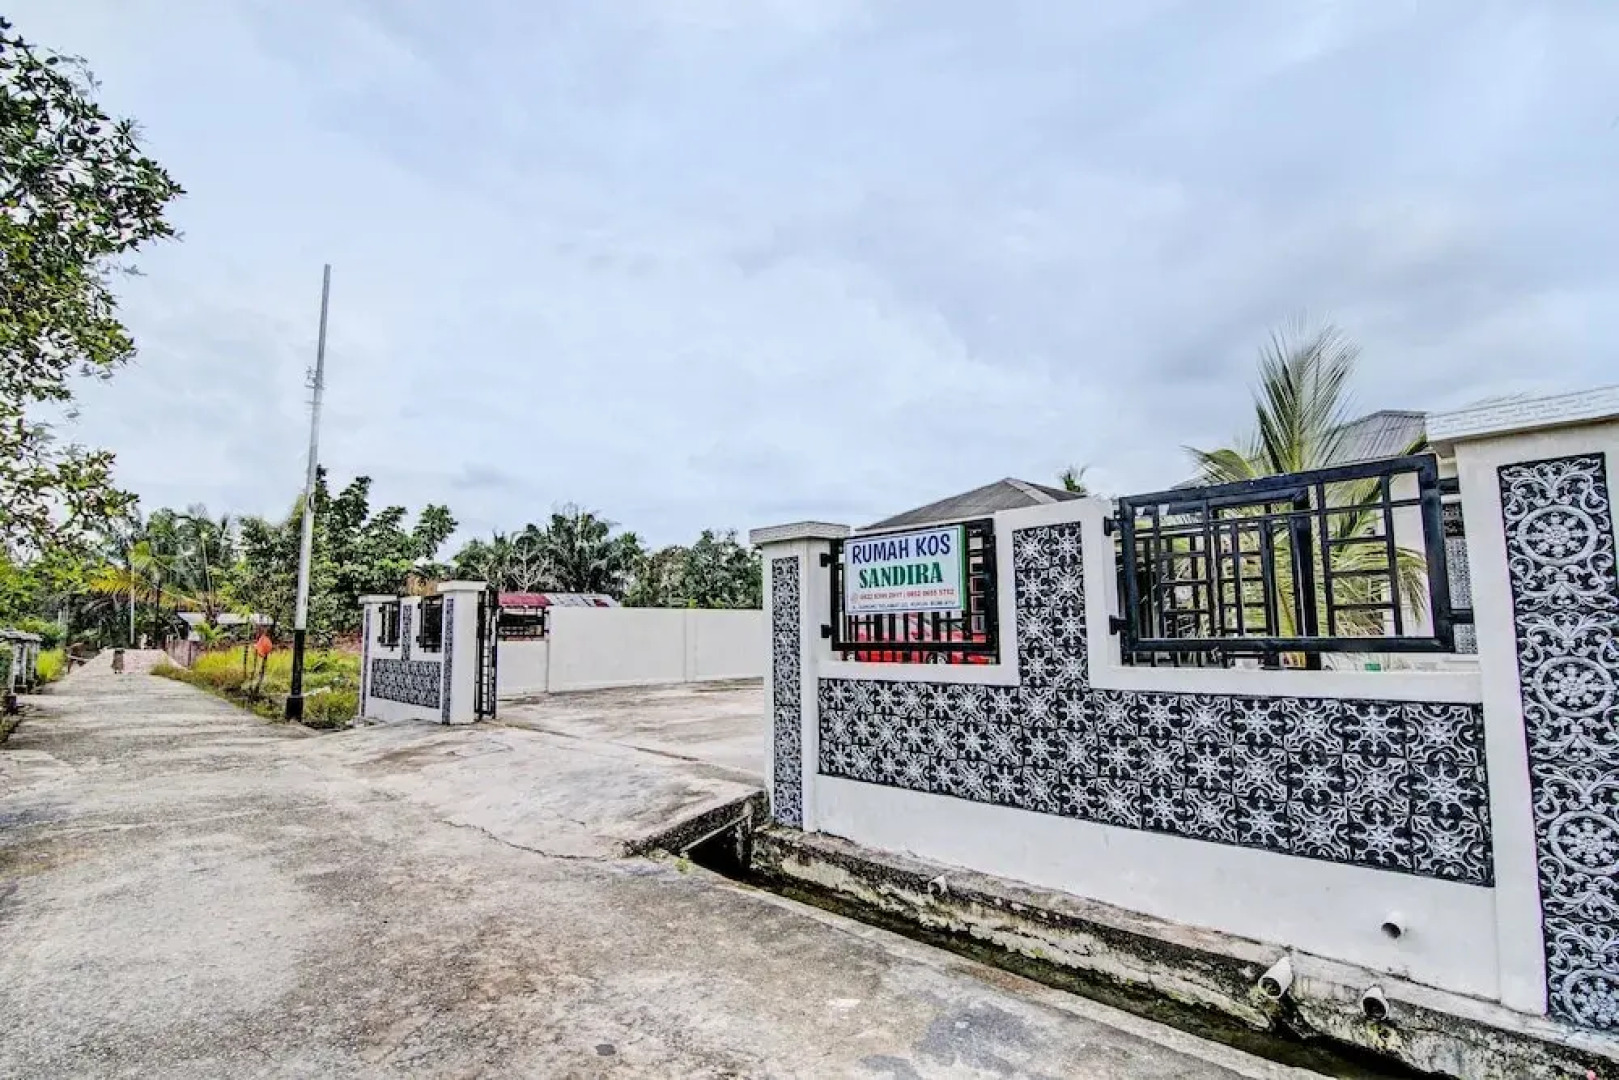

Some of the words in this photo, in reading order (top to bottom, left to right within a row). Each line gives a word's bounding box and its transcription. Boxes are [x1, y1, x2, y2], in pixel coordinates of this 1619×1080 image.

[852, 538, 909, 565] RUMAH
[915, 533, 951, 557] KOS
[859, 562, 943, 589] SANDIRA
